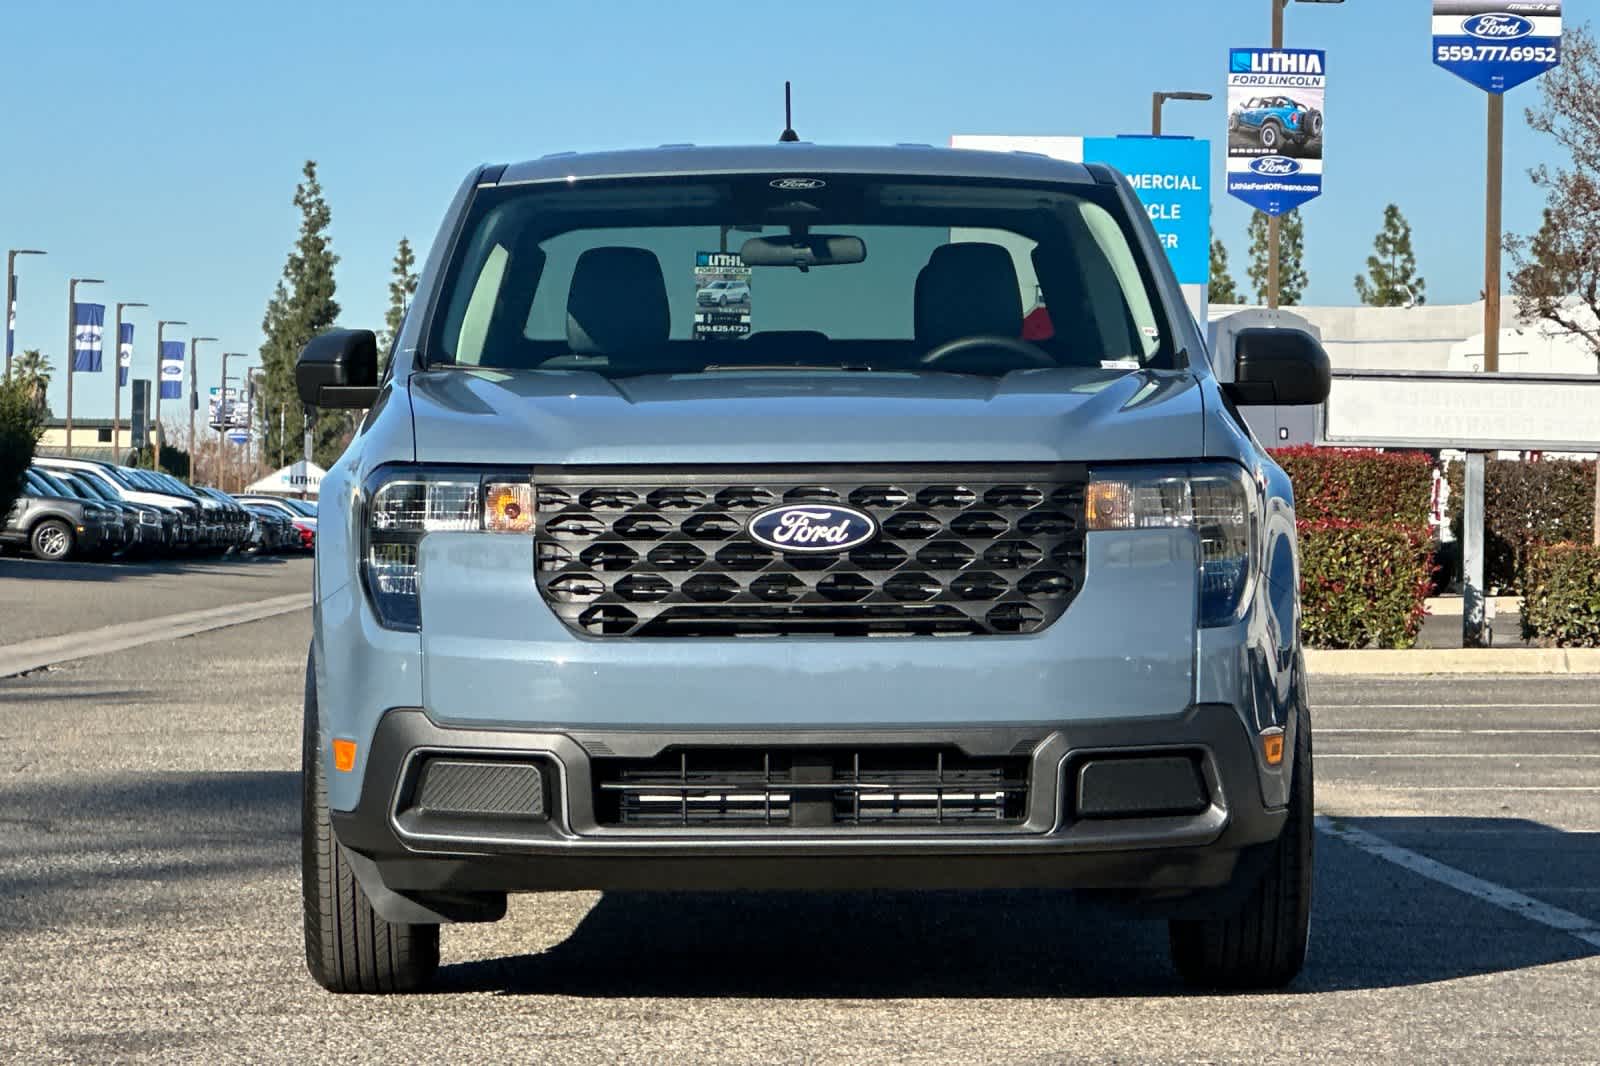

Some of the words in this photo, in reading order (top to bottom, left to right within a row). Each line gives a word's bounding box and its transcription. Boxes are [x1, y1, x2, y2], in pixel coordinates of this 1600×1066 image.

[1475, 15, 1520, 35] Ford
[1437, 45, 1557, 62] 559.777.6952
[1251, 52, 1322, 74] LITHIA
[1232, 75, 1265, 85] FORD
[1268, 75, 1321, 86] LINCOLN
[1258, 158, 1292, 173] Ford
[779, 179, 816, 189] Ford
[1126, 174, 1202, 190] MERCIAL
[1145, 203, 1182, 219] CLE
[773, 510, 851, 542] Ford
